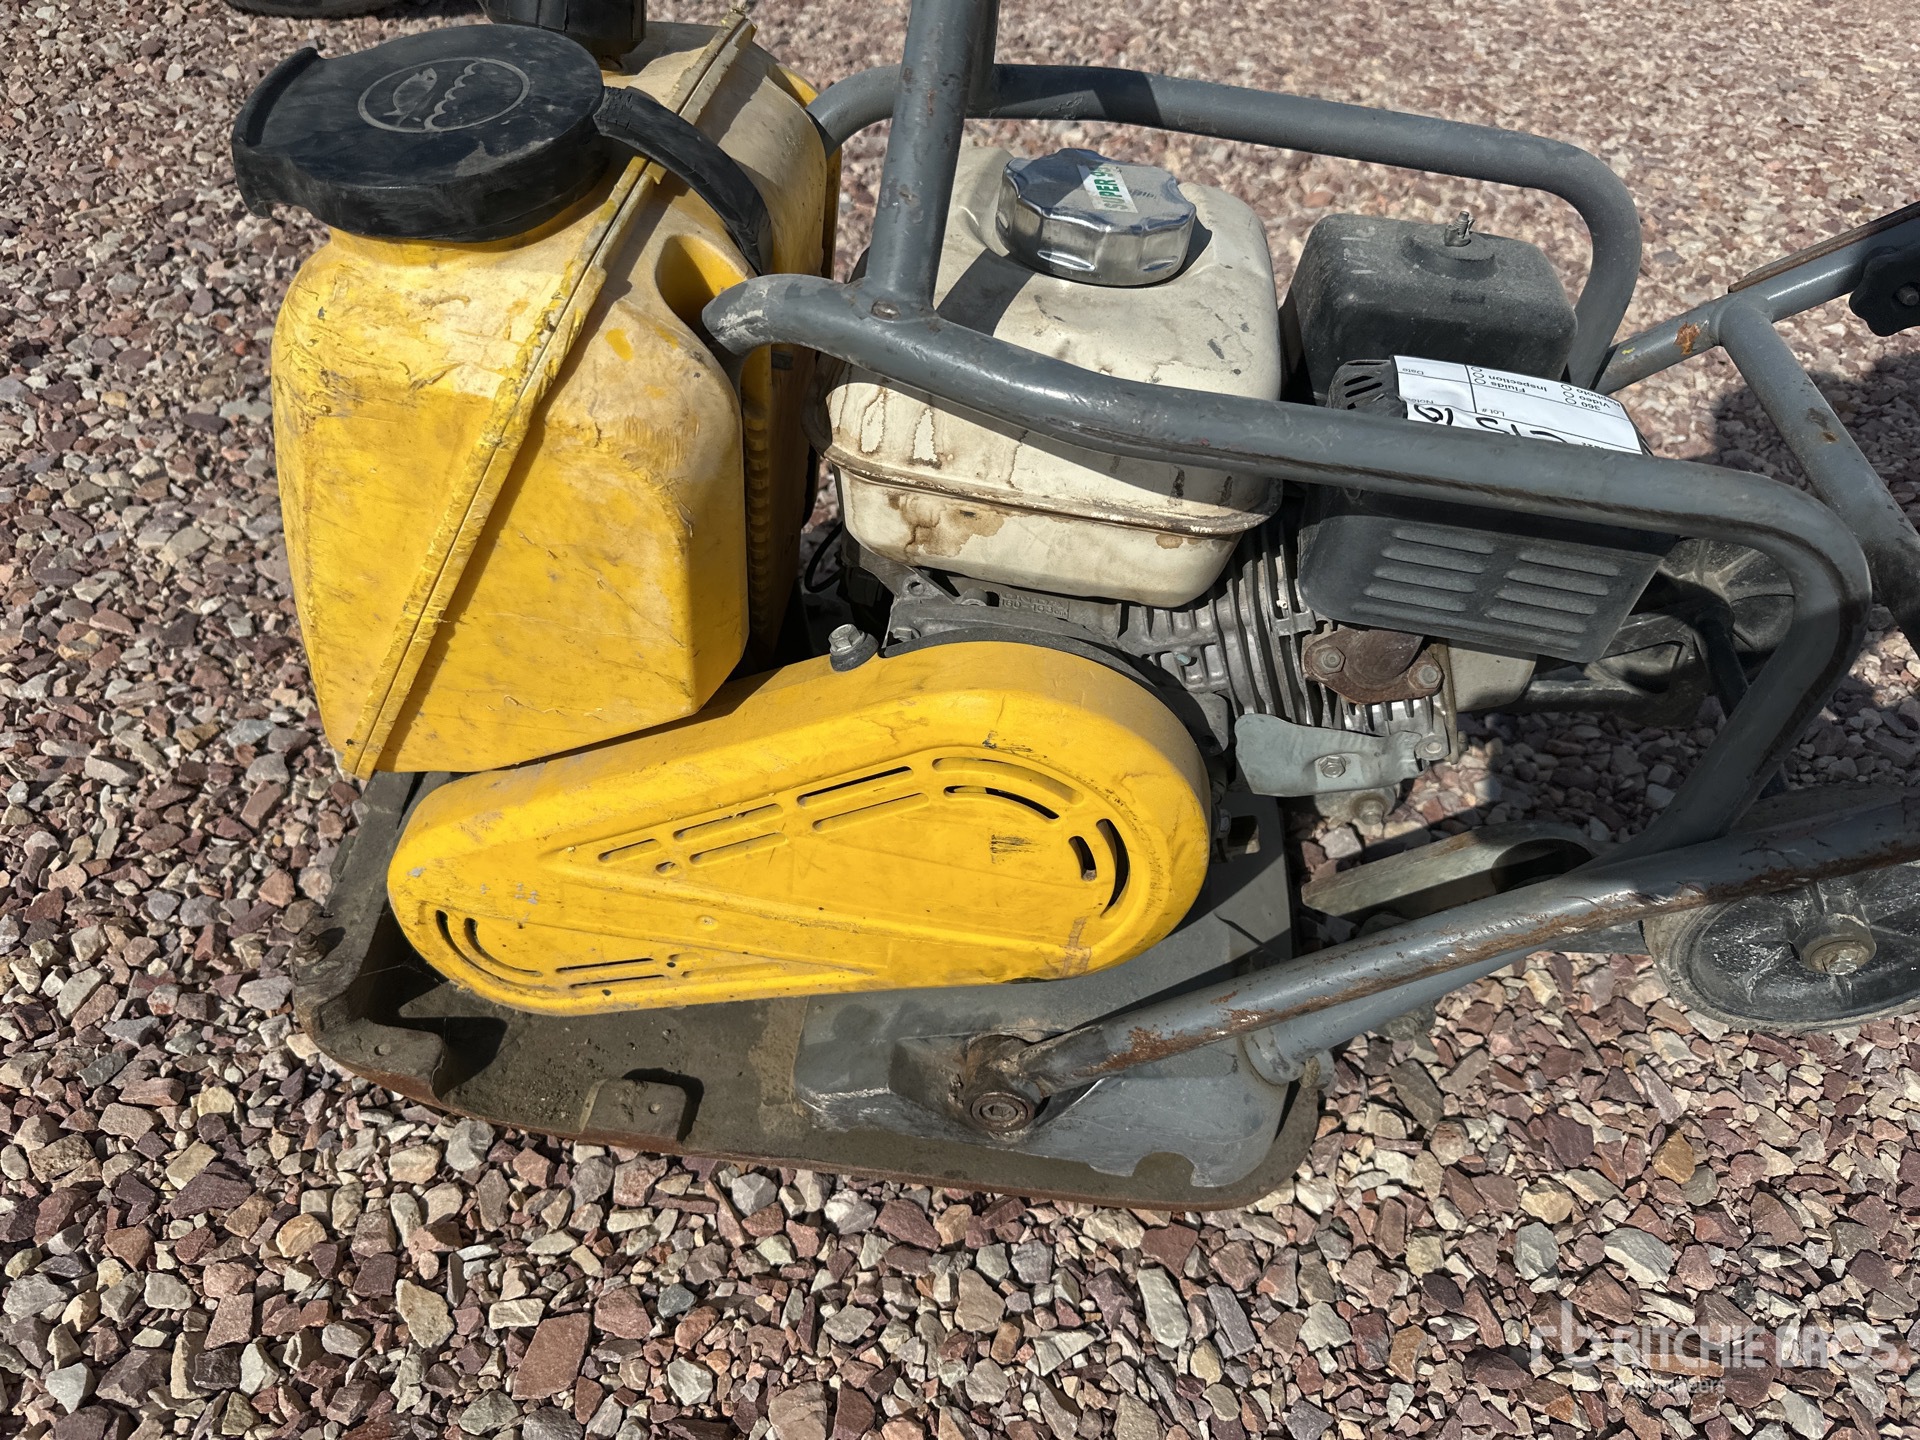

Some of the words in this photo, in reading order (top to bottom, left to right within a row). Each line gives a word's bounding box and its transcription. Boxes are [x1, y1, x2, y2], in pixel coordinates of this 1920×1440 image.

[1093, 179, 1129, 209] SUPER
[1488, 375, 1547, 392] Inspection
[1490, 381, 1526, 393] Fluids
[1579, 396, 1611, 408] Video
[1581, 402, 1601, 411] 360
